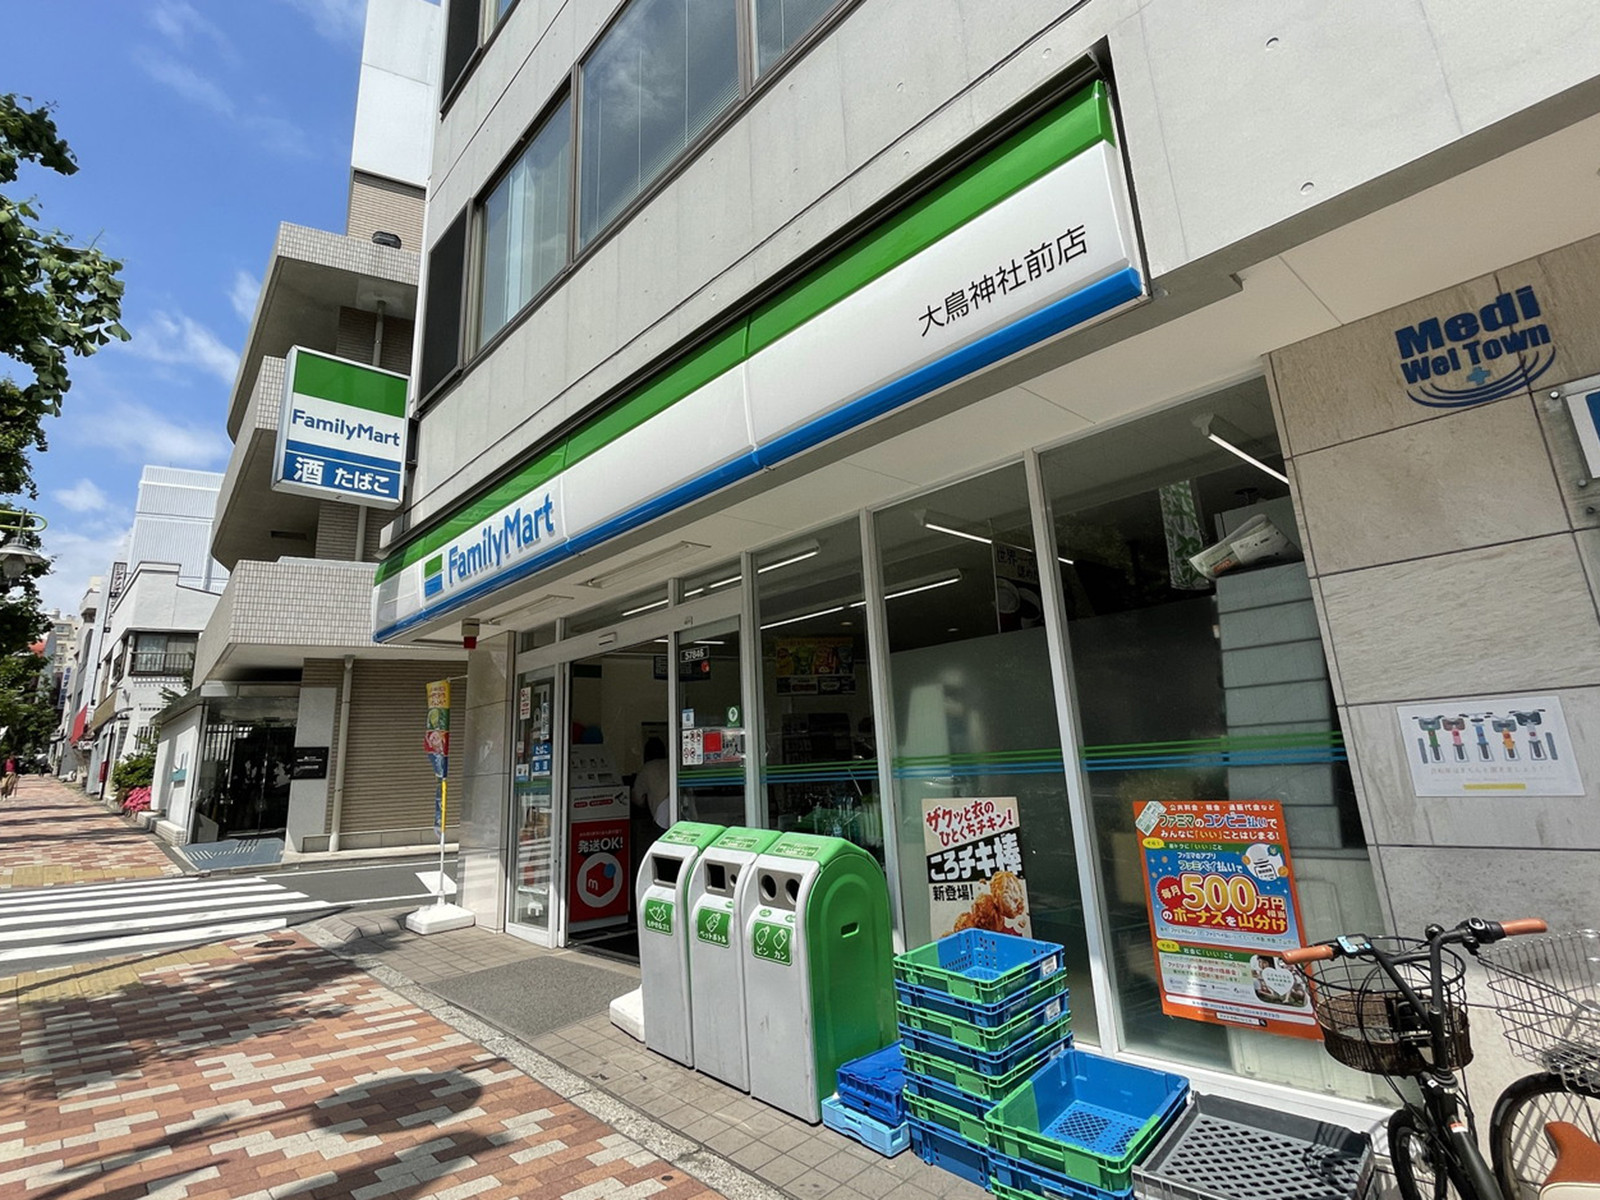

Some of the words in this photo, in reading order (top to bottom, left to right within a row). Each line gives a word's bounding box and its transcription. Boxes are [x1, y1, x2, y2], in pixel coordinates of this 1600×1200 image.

[918, 224, 1087, 337] 大鳥神社前店
[1395, 285, 1541, 359] Medi
[1401, 348, 1461, 384] Wel
[1463, 323, 1551, 365] Town
[292, 409, 400, 447] FamilyMart
[293, 456, 324, 485] 酒
[334, 467, 390, 495] たばこ
[448, 493, 554, 586] FamilyMart
[926, 800, 994, 832] ザクッと衣の
[1158, 813, 1278, 829] ファミマのコンビニ払いで
[578, 836, 624, 854] 発送OK!
[1161, 885, 1181, 899] 毎月
[1162, 908, 1287, 932] のボーナスを山分け
